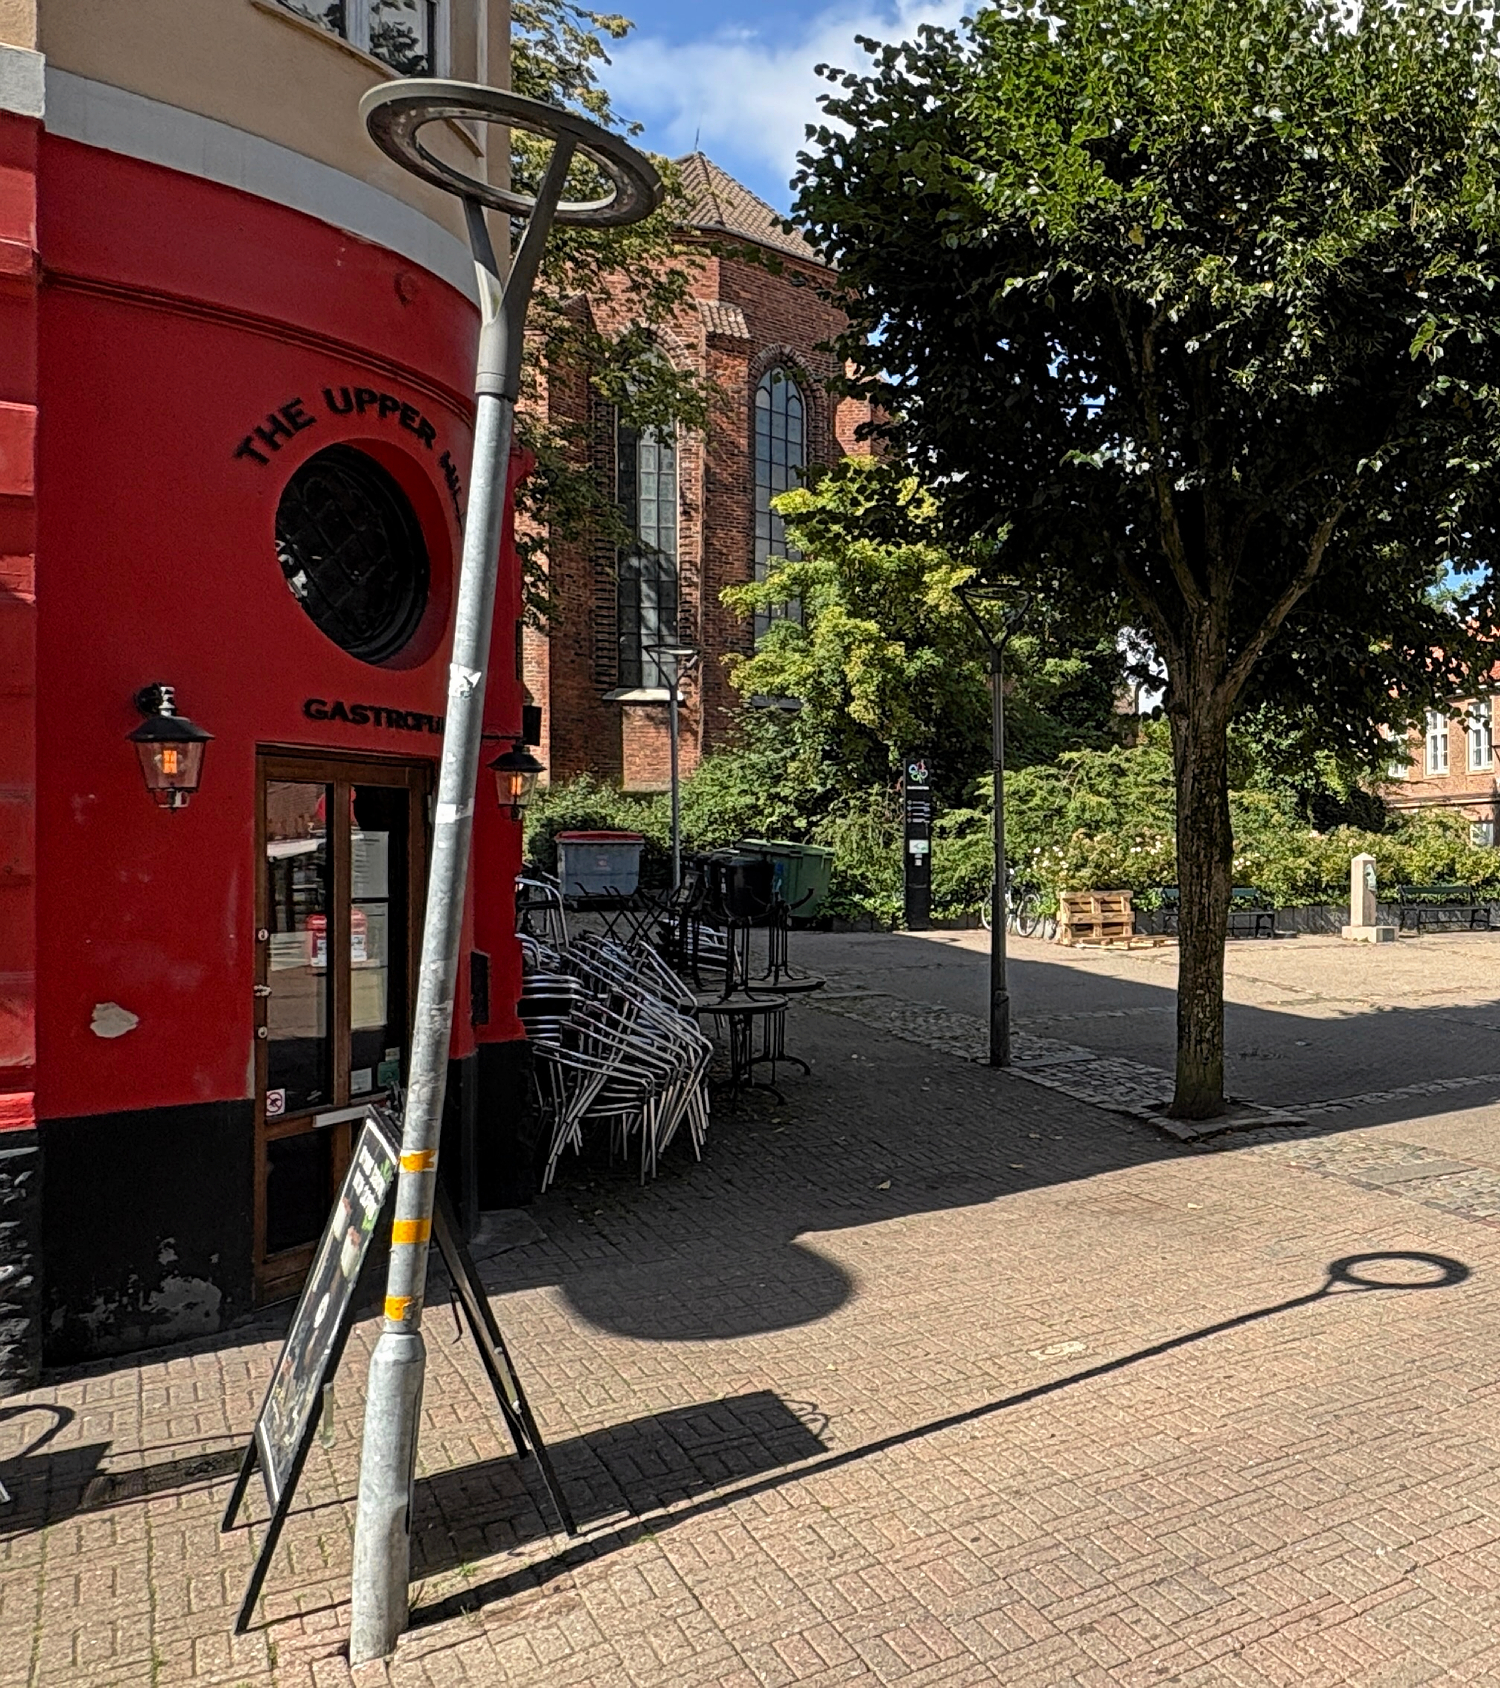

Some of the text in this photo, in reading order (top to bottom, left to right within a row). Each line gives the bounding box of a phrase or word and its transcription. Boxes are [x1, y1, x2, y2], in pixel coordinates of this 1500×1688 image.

[234, 397, 317, 466] THE
[322, 386, 437, 450] UPPER
[303, 698, 445, 735] GASTROPU
